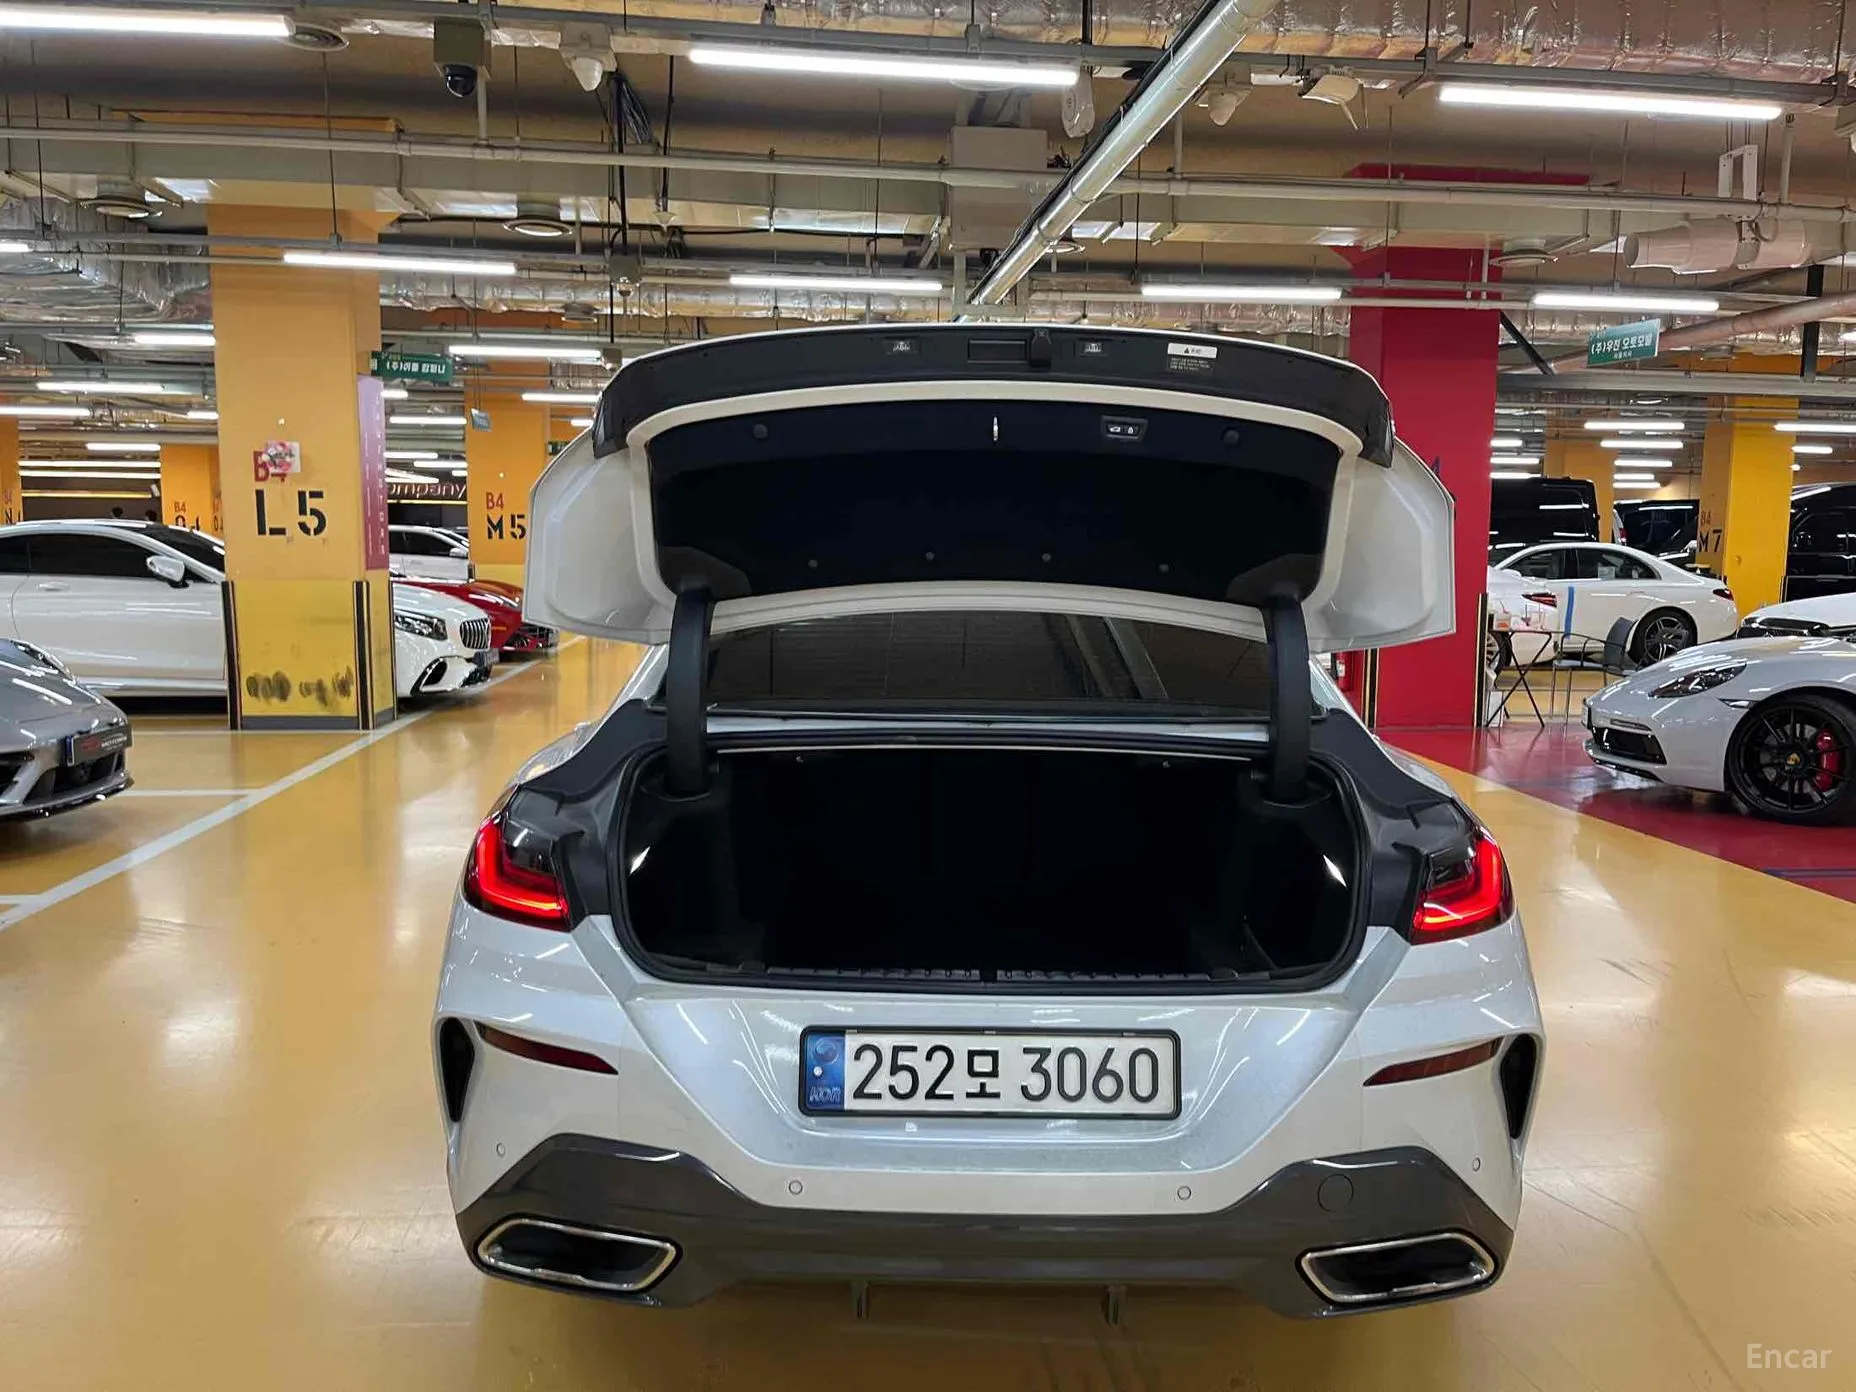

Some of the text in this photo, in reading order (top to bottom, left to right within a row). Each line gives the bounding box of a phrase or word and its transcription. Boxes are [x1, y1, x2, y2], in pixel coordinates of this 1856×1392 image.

[486, 492, 505, 510] B4
[852, 1043, 1160, 1103] 252모 3060
